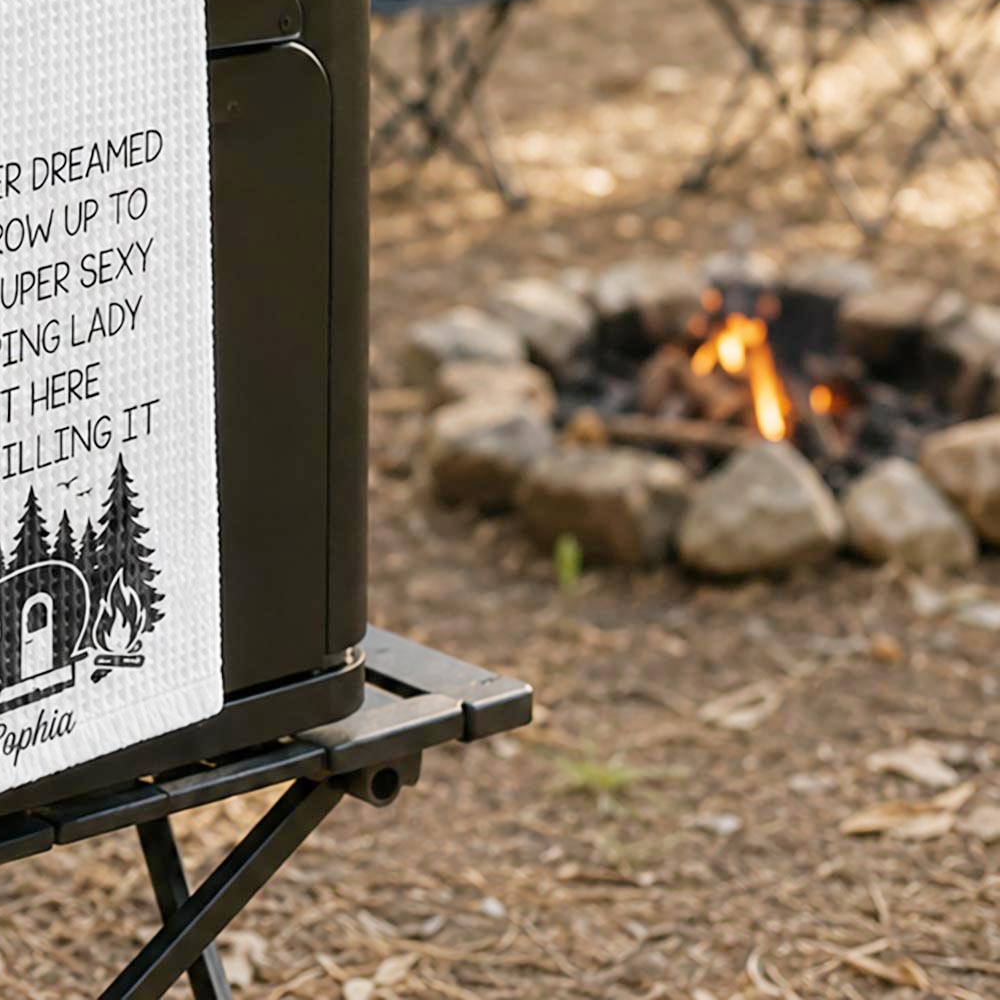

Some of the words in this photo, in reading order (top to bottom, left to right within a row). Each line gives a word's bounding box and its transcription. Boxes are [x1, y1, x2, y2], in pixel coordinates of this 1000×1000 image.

[32, 129, 163, 191] DREAMED
[64, 198, 99, 237] UP
[108, 187, 148, 224] TO
[80, 237, 154, 289] SEXY
[71, 295, 143, 347] LADY
[30, 361, 101, 417] HERE
[121, 398, 160, 443] IT
